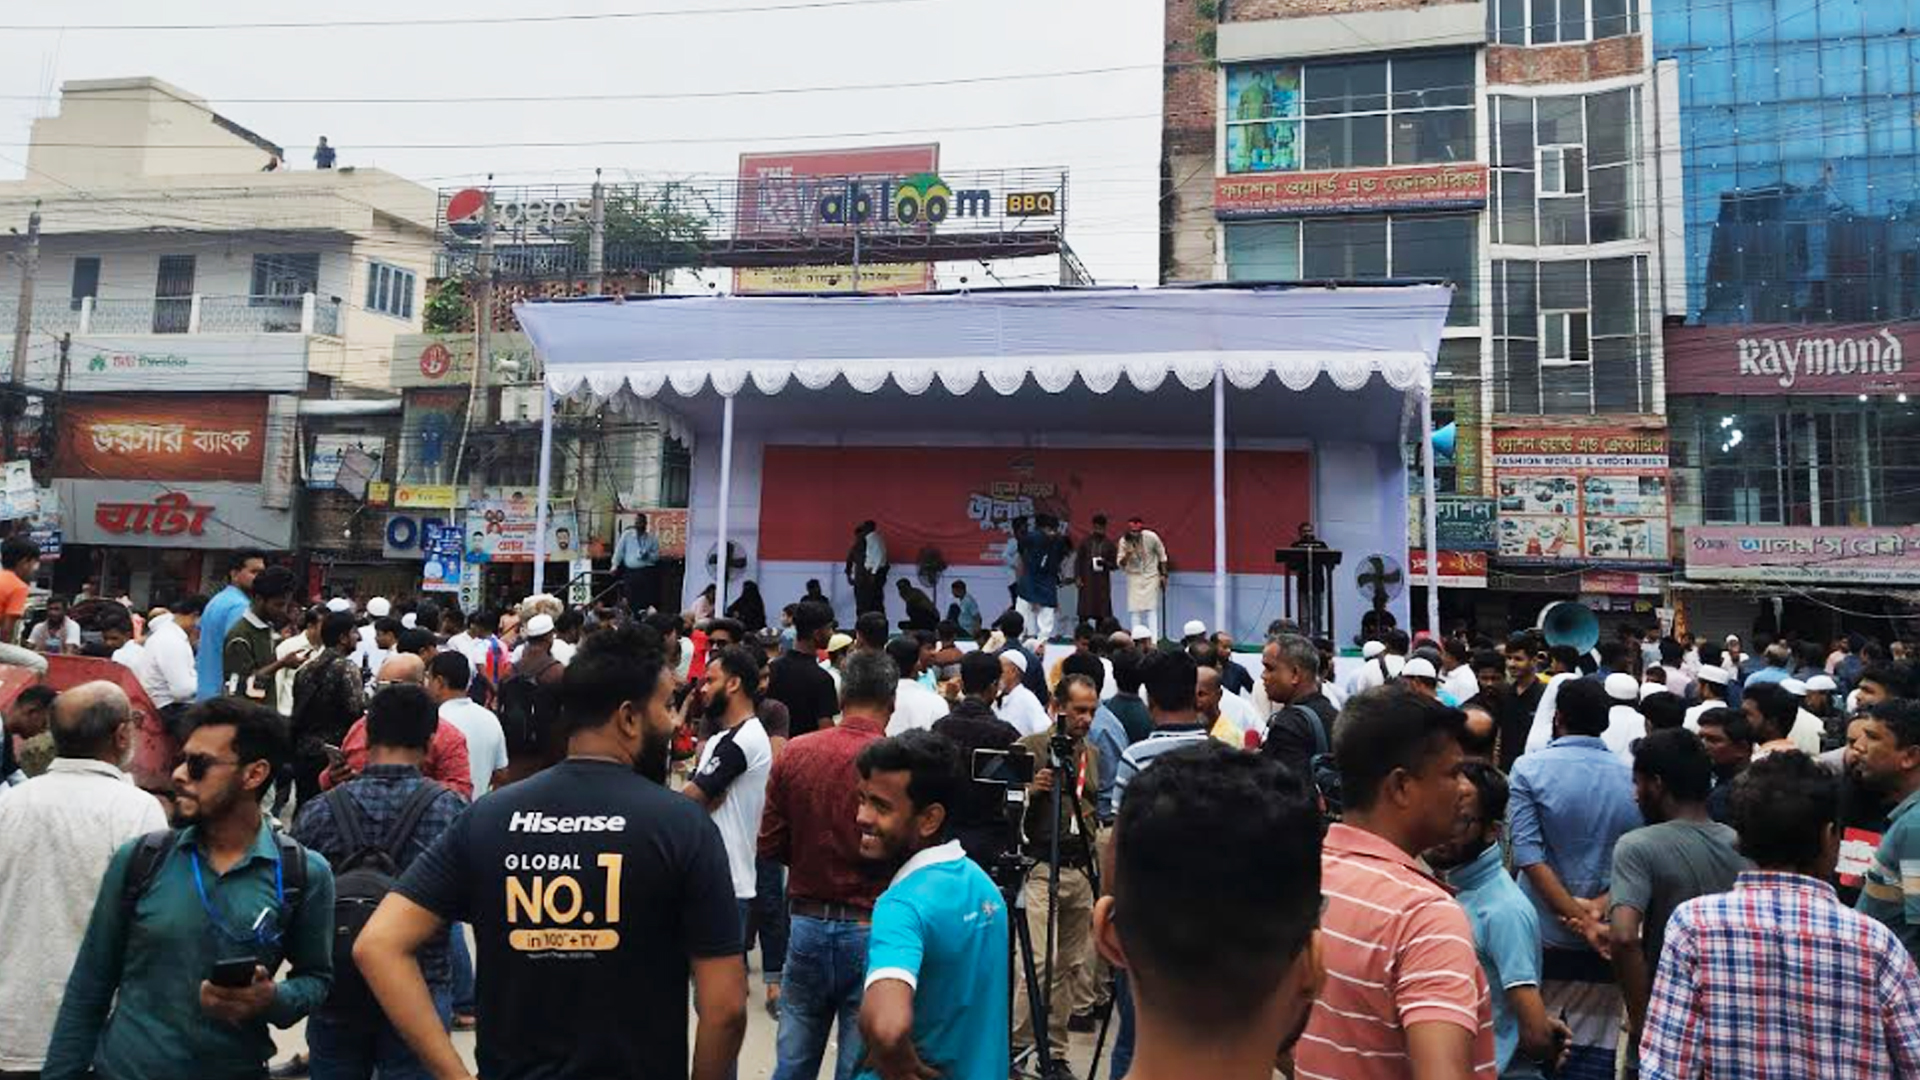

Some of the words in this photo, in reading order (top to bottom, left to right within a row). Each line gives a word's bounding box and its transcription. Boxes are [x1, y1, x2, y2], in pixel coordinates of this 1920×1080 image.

[1009, 194, 1053, 212] BBQ
[1736, 328, 1903, 387] Raymond
[192, 430, 252, 455] ব্যাংক
[95, 492, 215, 536] বাটা
[508, 811, 627, 833] Hisense
[505, 854, 581, 870] GLOBAL
[527, 933, 541, 947] in
[581, 933, 598, 947] TV
